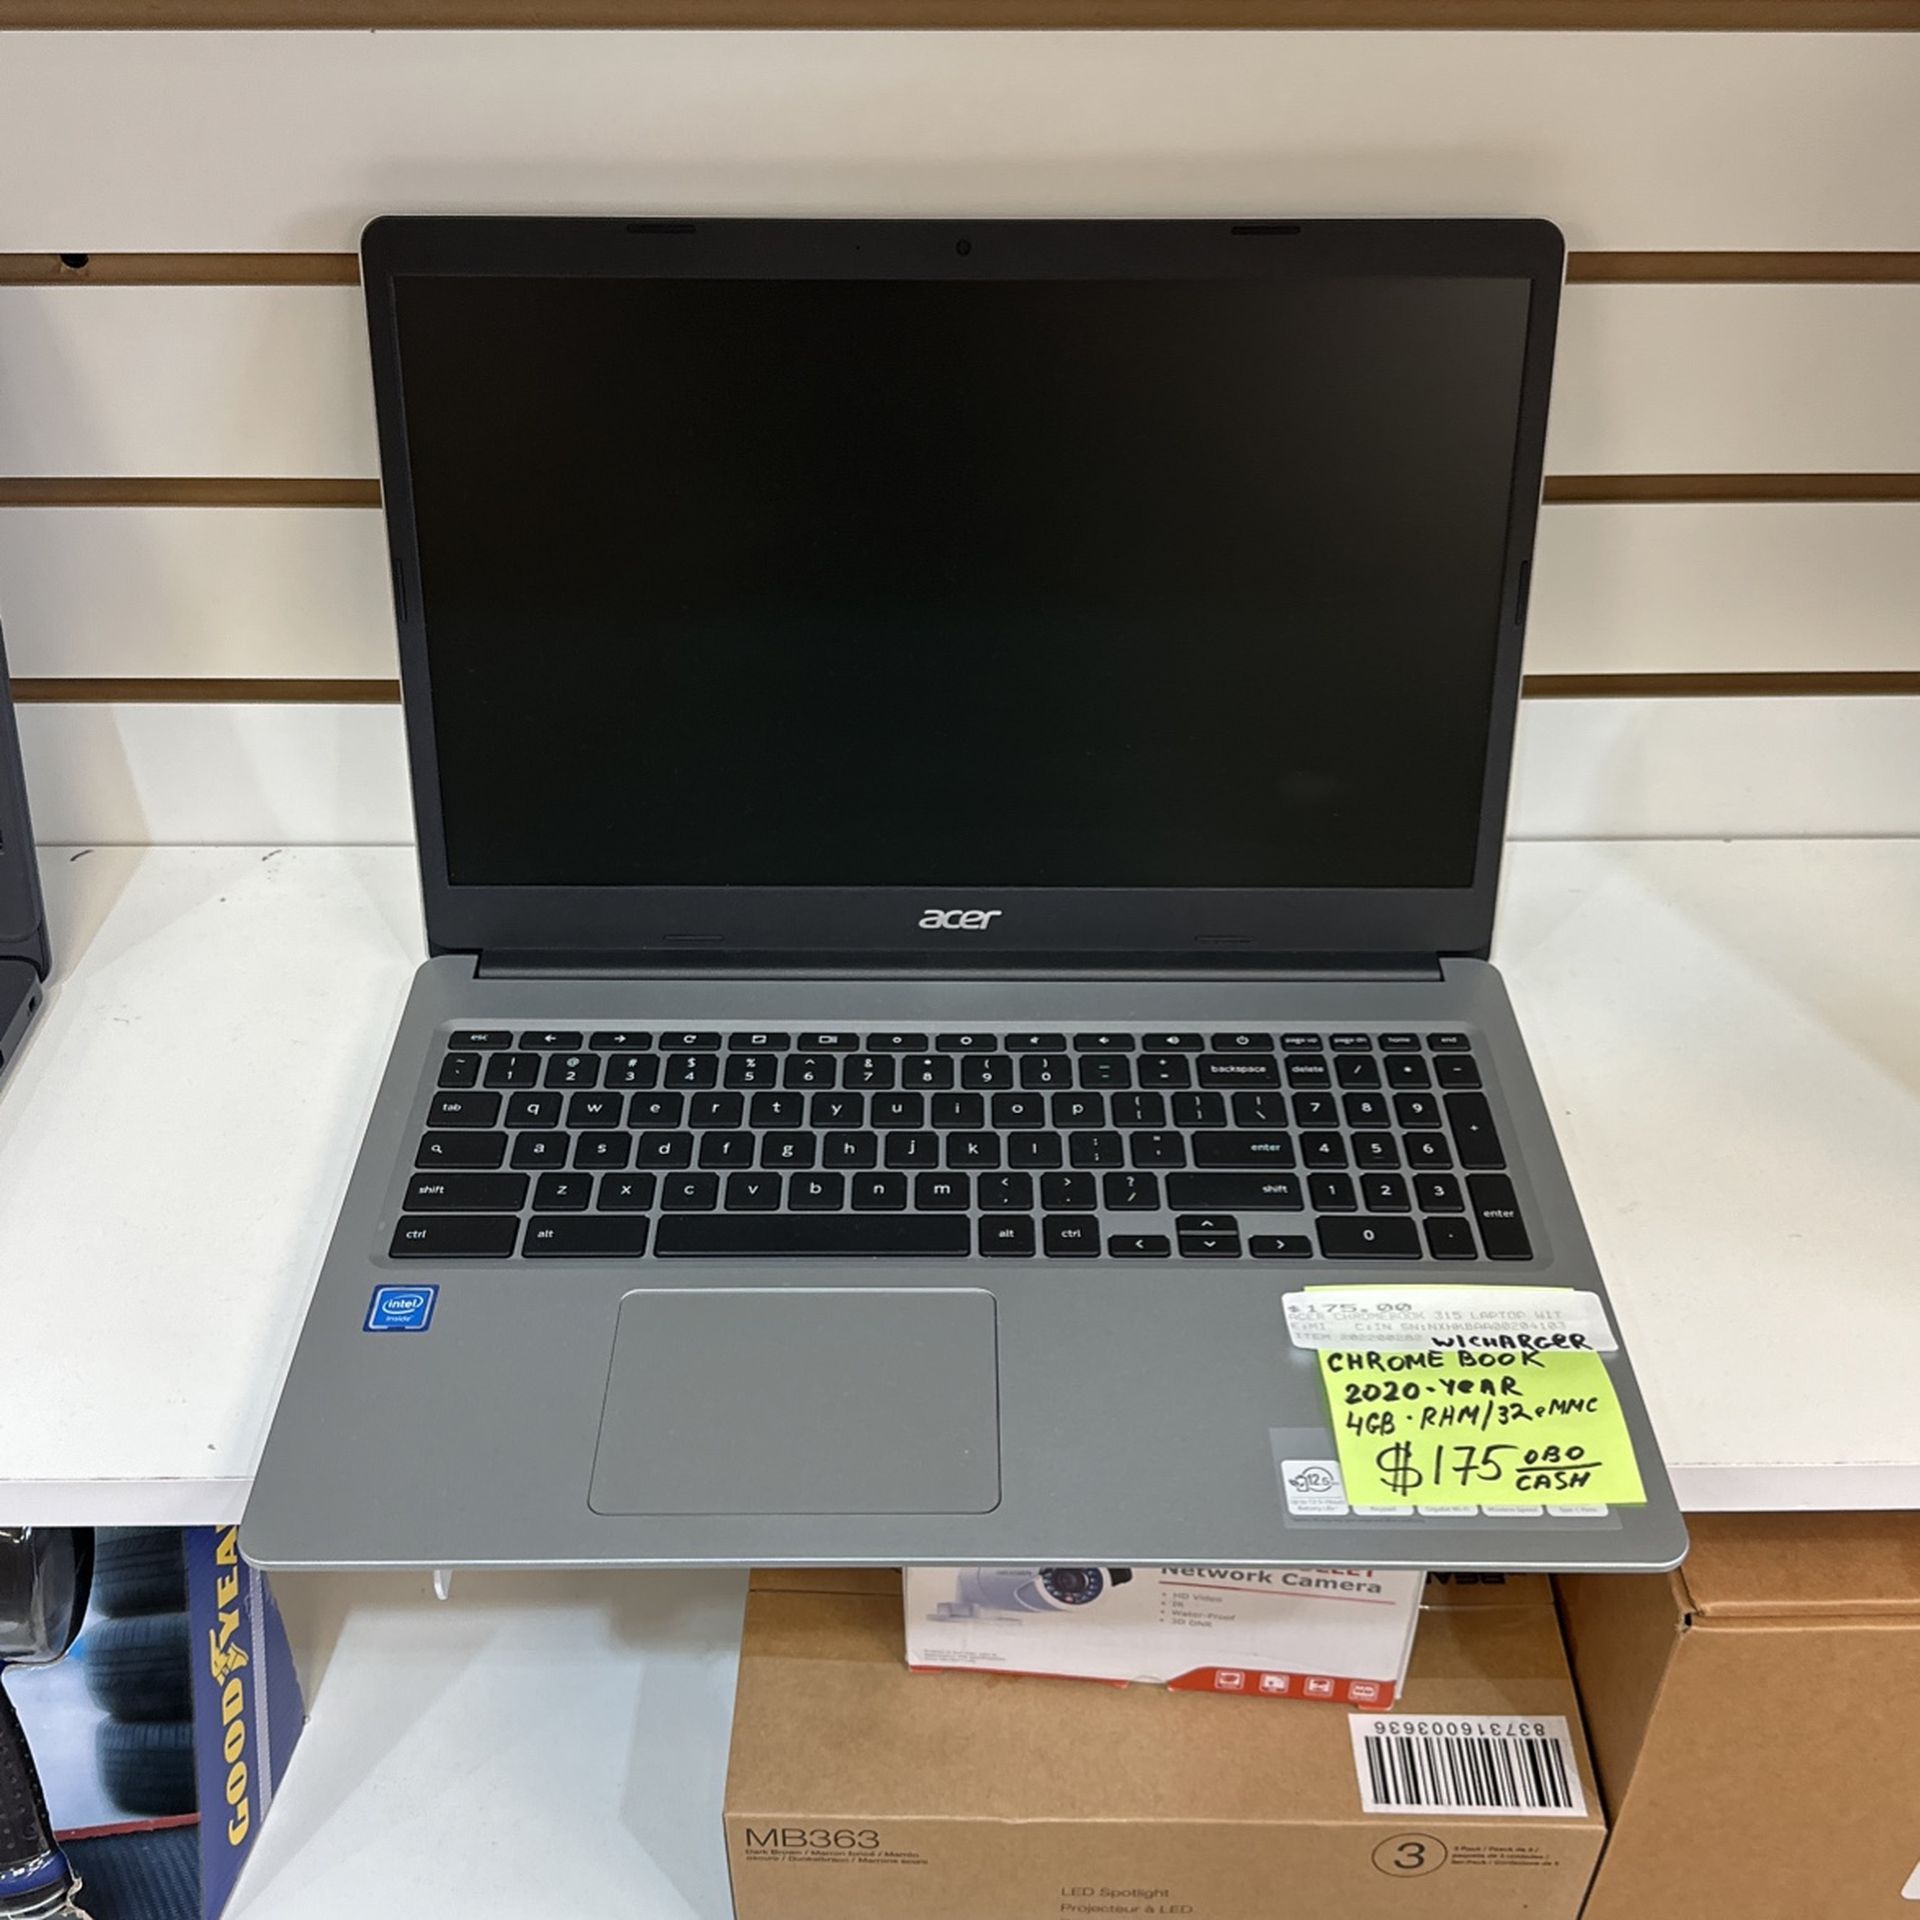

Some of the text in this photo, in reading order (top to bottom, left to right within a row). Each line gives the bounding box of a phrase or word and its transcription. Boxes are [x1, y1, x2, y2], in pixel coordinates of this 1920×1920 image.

[918, 909, 1002, 929] acer
[1210, 1065, 1267, 1074] backspace
[1291, 1065, 1325, 1073] delete
[442, 1103, 462, 1112] tab
[526, 1101, 1084, 1116] q w e r t y u i o p
[1310, 1102, 1423, 1113] 7 8 9
[533, 1143, 545, 1154] a
[597, 1143, 607, 1154] s
[658, 1142, 671, 1155] d
[723, 1142, 730, 1154] f
[781, 1144, 794, 1158] g
[843, 1142, 855, 1154] h
[907, 1140, 916, 1155] j
[968, 1142, 979, 1155] k
[1250, 1143, 1281, 1152] enter
[1319, 1143, 1434, 1154] 4 5 6
[418, 1185, 445, 1194] shift
[556, 1181, 951, 1196] z x c v b n m
[1262, 1184, 1288, 1194] shift
[1380, 1184, 1392, 1196] 2
[1434, 1185, 1445, 1197] 3
[1483, 1209, 1514, 1218] enter
[405, 1229, 427, 1239] ctrl
[537, 1229, 554, 1238] alt
[998, 1229, 1015, 1238] alt
[1061, 1229, 1082, 1238] ctrl
[1362, 1229, 1375, 1241] 0
[387, 1298, 419, 1309] intel
[1288, 1303, 1412, 1313] $175.00
[1434, 1311, 1462, 1320] 315
[1470, 1311, 1527, 1320] LAPTOP
[1327, 1350, 1545, 1373] CHROME BOOK
[1346, 1411, 1396, 1436] 4GB
[1524, 1445, 1585, 1465] OBO
[1376, 1440, 1519, 1496] $175
[1515, 1471, 1591, 1491] CASH
[1281, 1573, 1383, 1594] Camera
[1373, 1720, 1546, 1737] 837316003636
[745, 1827, 881, 1849] MB363
[1393, 1841, 1426, 1869] 3
[1061, 1887, 1170, 1899] LED Spotlight
[1060, 1903, 1141, 1914] Projecteur
[1159, 1904, 1193, 1914] LED
